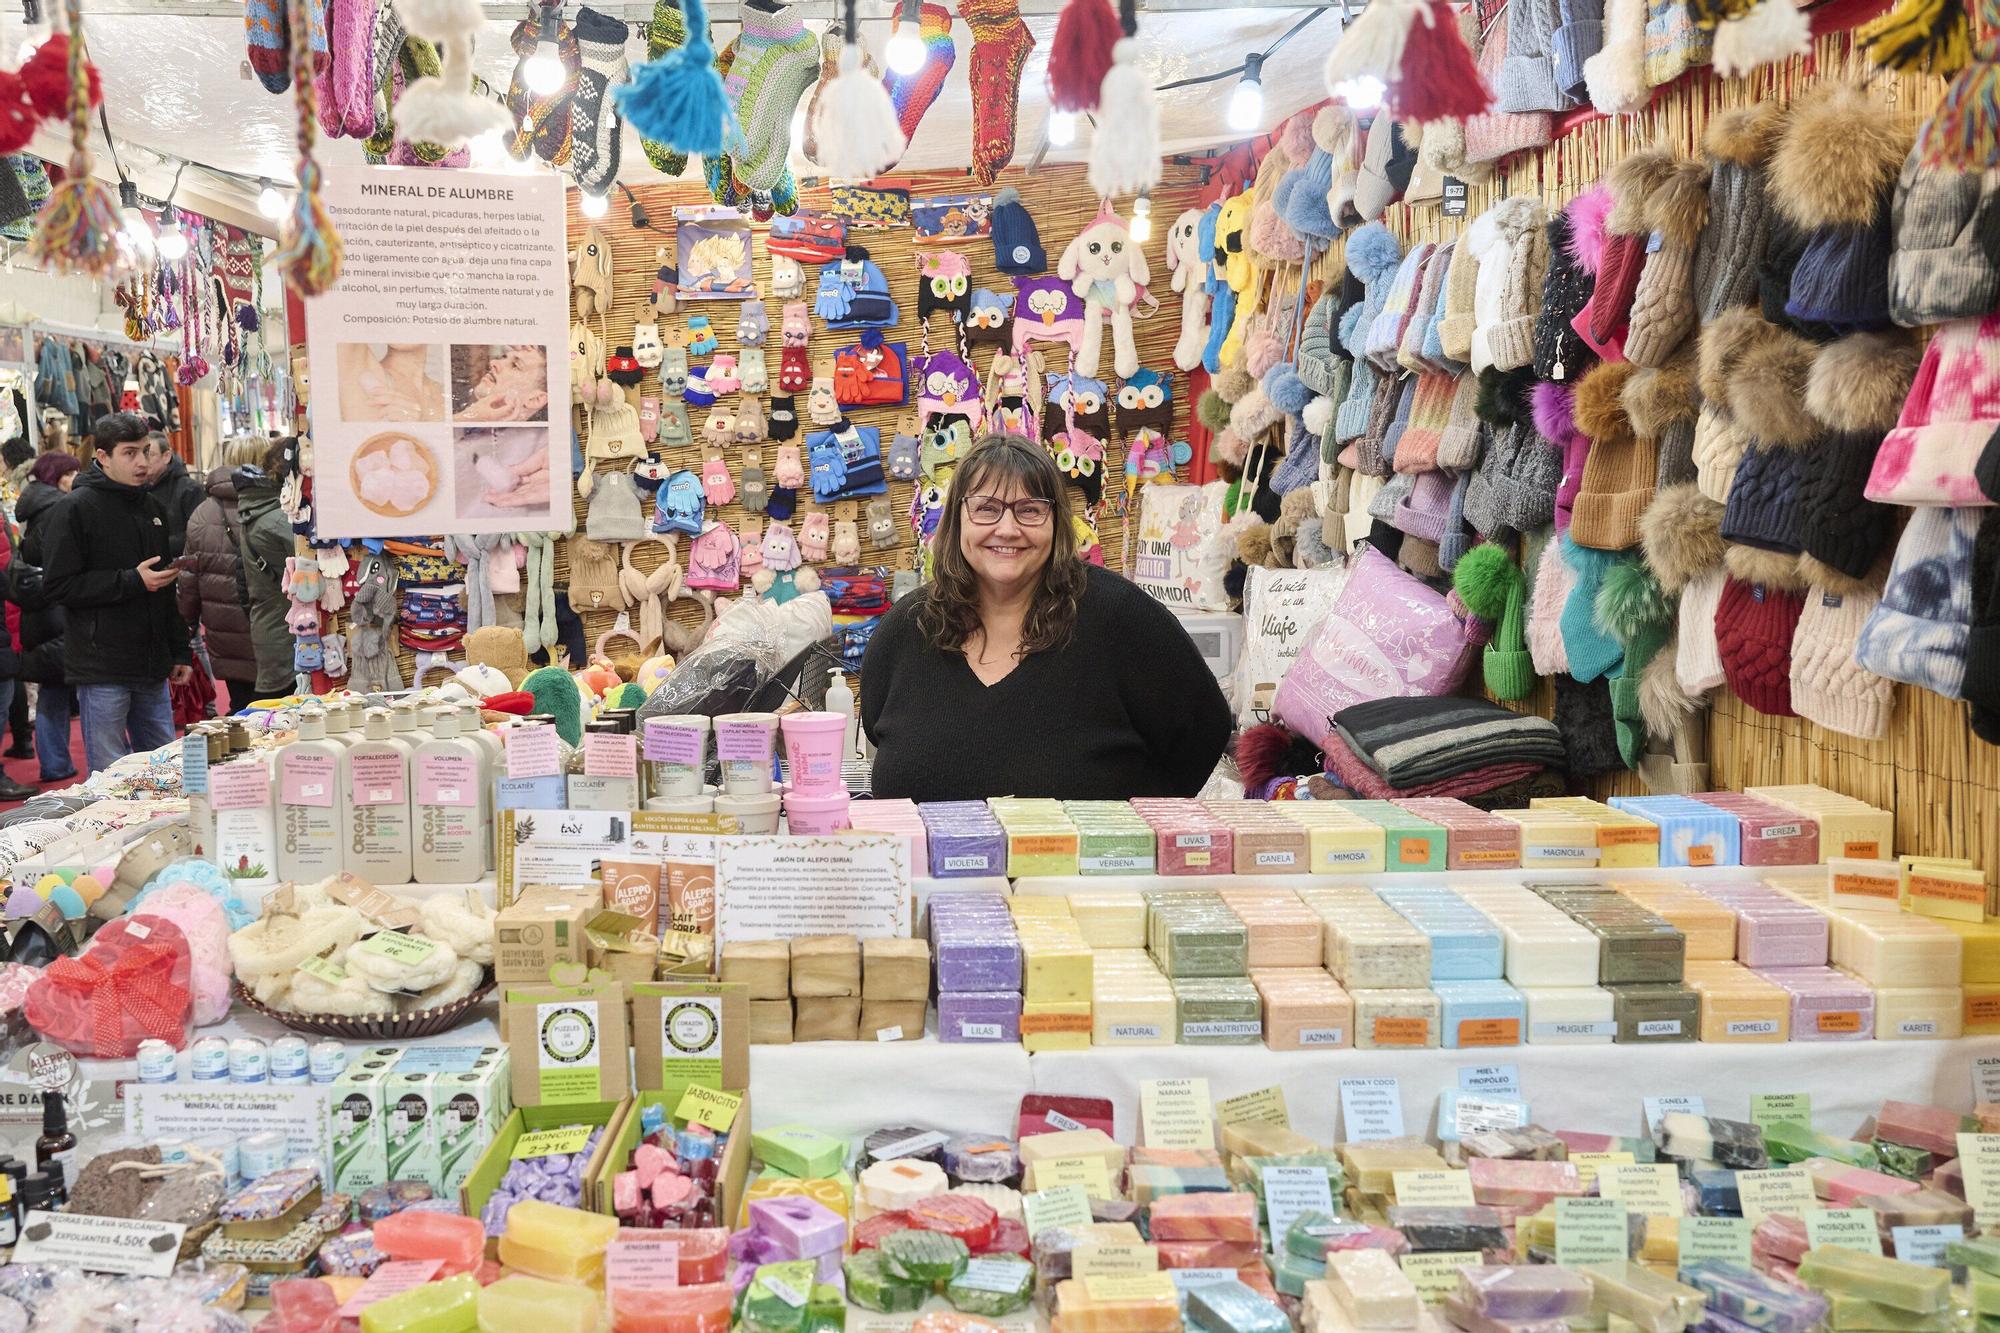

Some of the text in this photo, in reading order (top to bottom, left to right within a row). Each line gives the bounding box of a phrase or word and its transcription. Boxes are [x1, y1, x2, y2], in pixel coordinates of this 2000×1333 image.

[361, 184, 514, 201] MINERAL DE ALUMBRE
[329, 205, 545, 222] Desodorante natural, picaduras, herpes labial,
[381, 223, 393, 231] de
[395, 223, 404, 232] la
[406, 223, 424, 234] piel
[425, 225, 466, 236] después
[468, 226, 482, 235] del
[484, 226, 522, 236] afeitado
[532, 228, 540, 237] la
[375, 239, 499, 251] cauterizante, antiséptico y
[363, 254, 420, 263] ligeramente
[469, 256, 489, 266] deja
[511, 257, 528, 266] fina
[529, 260, 552, 270] capa
[353, 269, 540, 282] mineral invisible que mancha la ropa.
[341, 284, 381, 293] alcohol,
[383, 285, 398, 293] sin
[450, 286, 500, 295] totalmente
[502, 287, 534, 296] natural
[535, 289, 541, 297] y
[542, 288, 554, 296] de
[396, 301, 417, 310] muy
[419, 301, 442, 311] larga
[343, 314, 538, 326] Composición: Potasio de alumbre natural.
[1151, 541, 1171, 556] UNA
[1136, 558, 1165, 577] RATITA
[1261, 614, 1298, 643] Viaje
[1766, 825, 1797, 837] CEREZA
[1184, 836, 1205, 845] UVAS
[1333, 852, 1366, 862] MIMOSA
[1542, 847, 1586, 857] MAGNOLIA
[948, 858, 985, 868] VIOLETAS
[1099, 858, 1135, 868] VERBENA
[1259, 853, 1292, 864] CANELA
[618, 884, 651, 898] ALEPPO
[672, 913, 694, 921] LAIT
[672, 923, 701, 934] CORPS
[577, 988, 594, 996] SOAP
[554, 1025, 581, 1033] PUZZLES
[970, 1026, 994, 1036] LILAS
[1115, 1027, 1155, 1037] NATURAL
[1184, 1023, 1260, 1034] OLIVA-NUTRITIVO
[1556, 1024, 1593, 1033] MUGUET
[1643, 1022, 1674, 1032] ARGAN
[1732, 1022, 1771, 1033] POMELO
[1902, 1023, 1933, 1032] KARITE
[1305, 1031, 1336, 1043] JAZMÍN
[30, 1051, 71, 1069] ALEPPO
[1476, 1067, 1493, 1075] MIEL
[1469, 1075, 1510, 1085] PROPÓLEO
[687, 1087, 738, 1109] JABONCITO
[1158, 1089, 1192, 1097] NARANJA
[184, 1102, 221, 1110] MINERAL
[236, 1103, 278, 1111] ALUMBRE
[697, 1108, 713, 1121] 1€
[1052, 1115, 1079, 1130] FRESA
[519, 1127, 590, 1144] JABONCITOS
[1277, 1168, 1313, 1176] ROMERO
[1742, 1170, 1806, 1180] ALGAS MARINAS
[1567, 1200, 1615, 1208] AGUACATE
[1826, 1211, 1852, 1219] ROSA
[46, 1213, 81, 1225] PIEDRAS
[82, 1217, 93, 1226] DE
[96, 1218, 117, 1228] LAVA
[1696, 1220, 1734, 1228] AZAHAR
[1816, 1222, 1867, 1232] MOSQUETA
[1913, 1229, 1942, 1237] MIRRA
[55, 1231, 147, 1248] EXFOLIANTES 4,50€
[1097, 1248, 1131, 1256] AZUFRE
